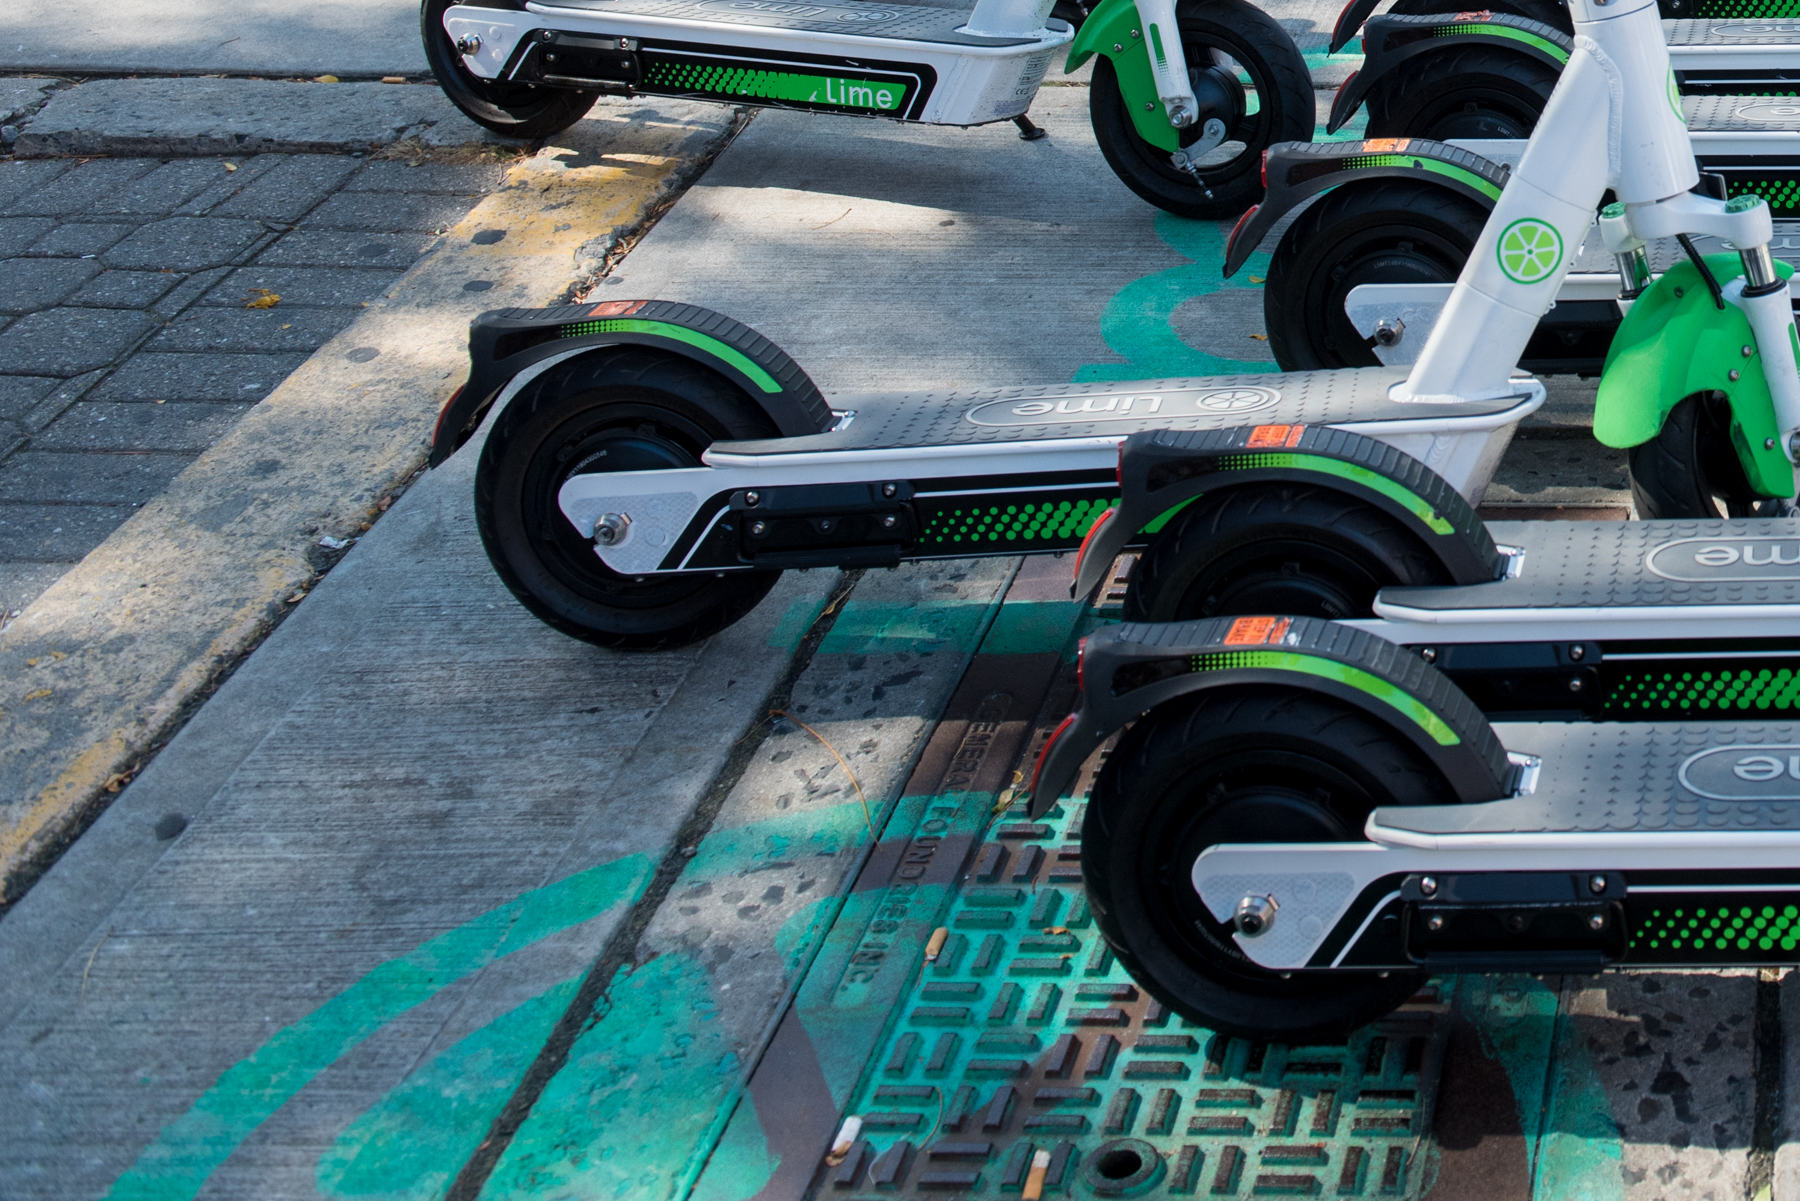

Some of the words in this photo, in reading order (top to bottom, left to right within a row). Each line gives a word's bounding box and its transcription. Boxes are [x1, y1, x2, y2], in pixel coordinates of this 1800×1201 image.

[729, 1, 828, 18] Lime
[826, 77, 893, 109] Lime
[1011, 392, 1164, 420] Lime
